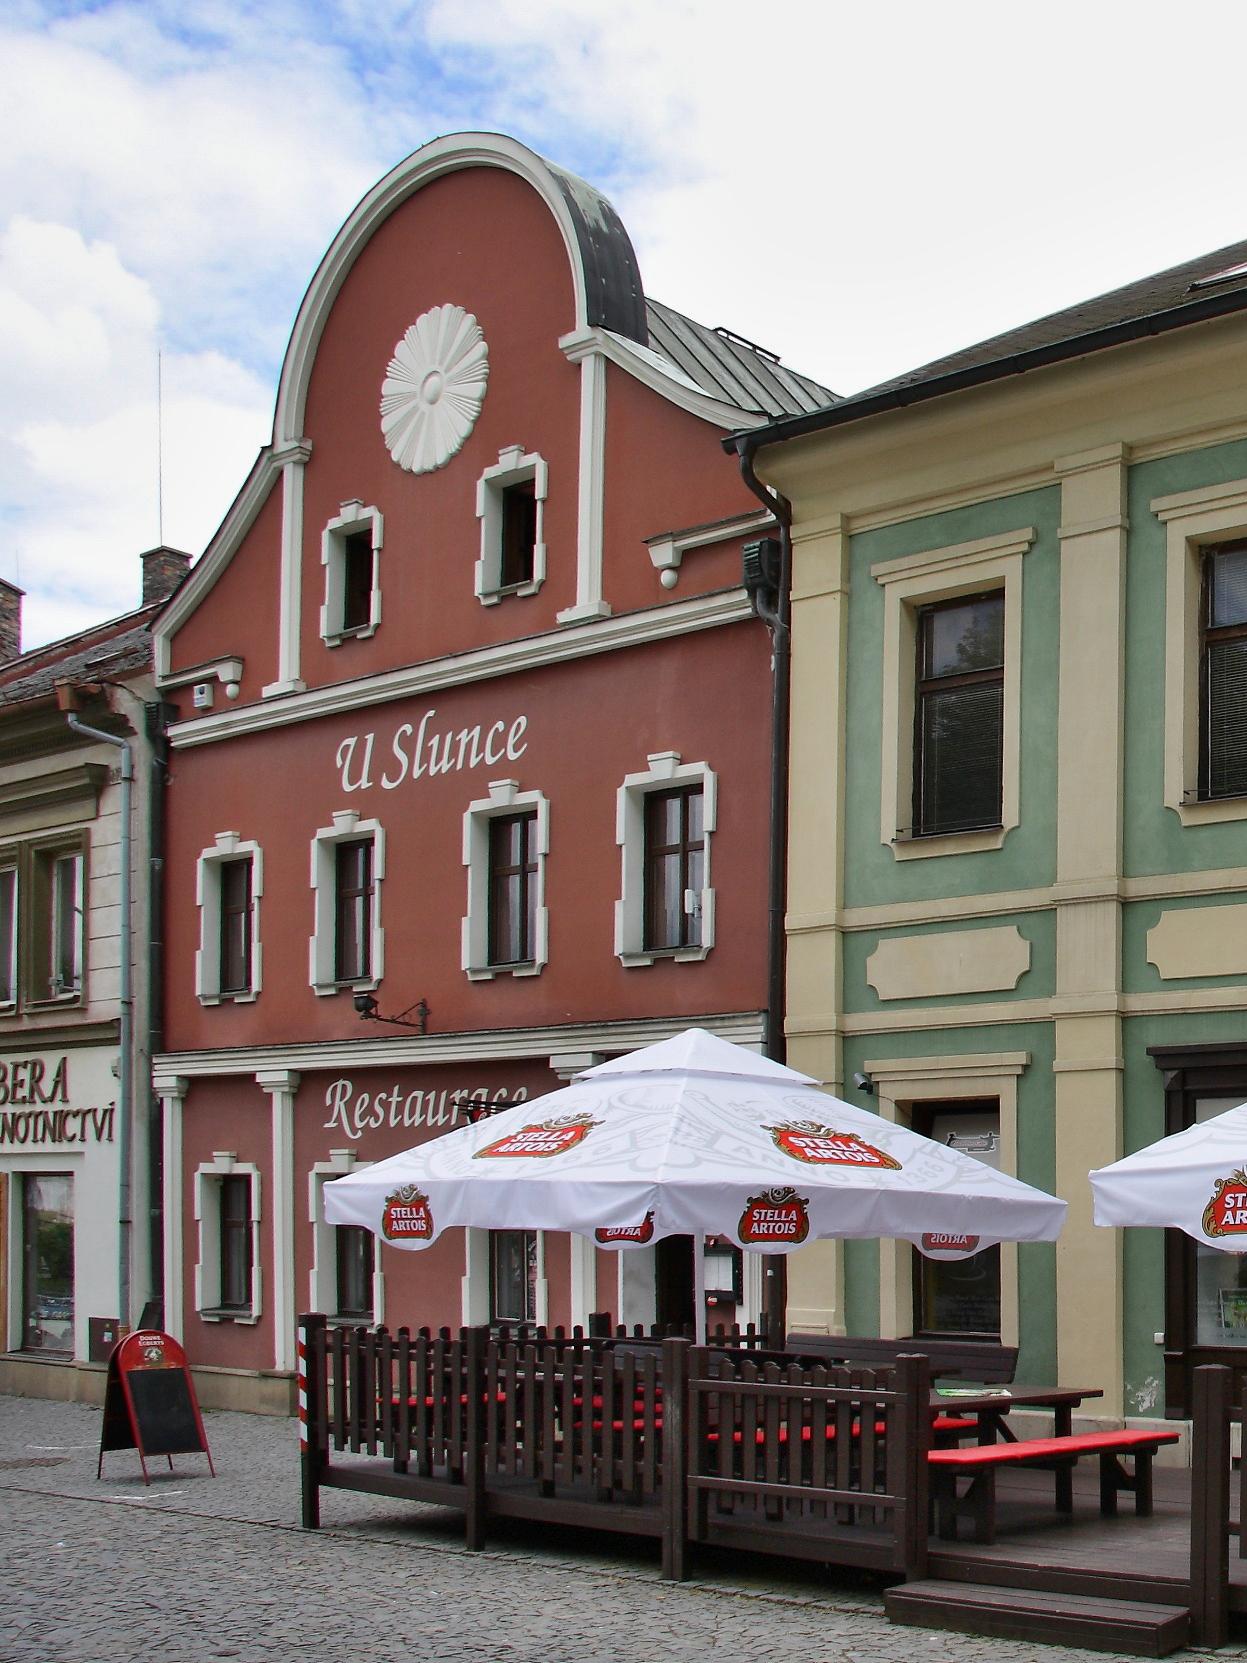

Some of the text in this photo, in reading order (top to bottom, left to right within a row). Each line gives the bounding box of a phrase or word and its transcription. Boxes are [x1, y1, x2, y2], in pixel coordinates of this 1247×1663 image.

[336, 709, 529, 793] U Slunce
[511, 1130, 577, 1143] STELLA
[492, 1141, 562, 1153] ARTOIS
[787, 1136, 867, 1152] STELLA
[804, 1148, 881, 1164] ARTOIS
[390, 1207, 426, 1218] STELLA
[752, 1208, 798, 1221] STELLA
[391, 1219, 427, 1231] ARTOIS
[750, 1221, 797, 1234] ARTOIS
